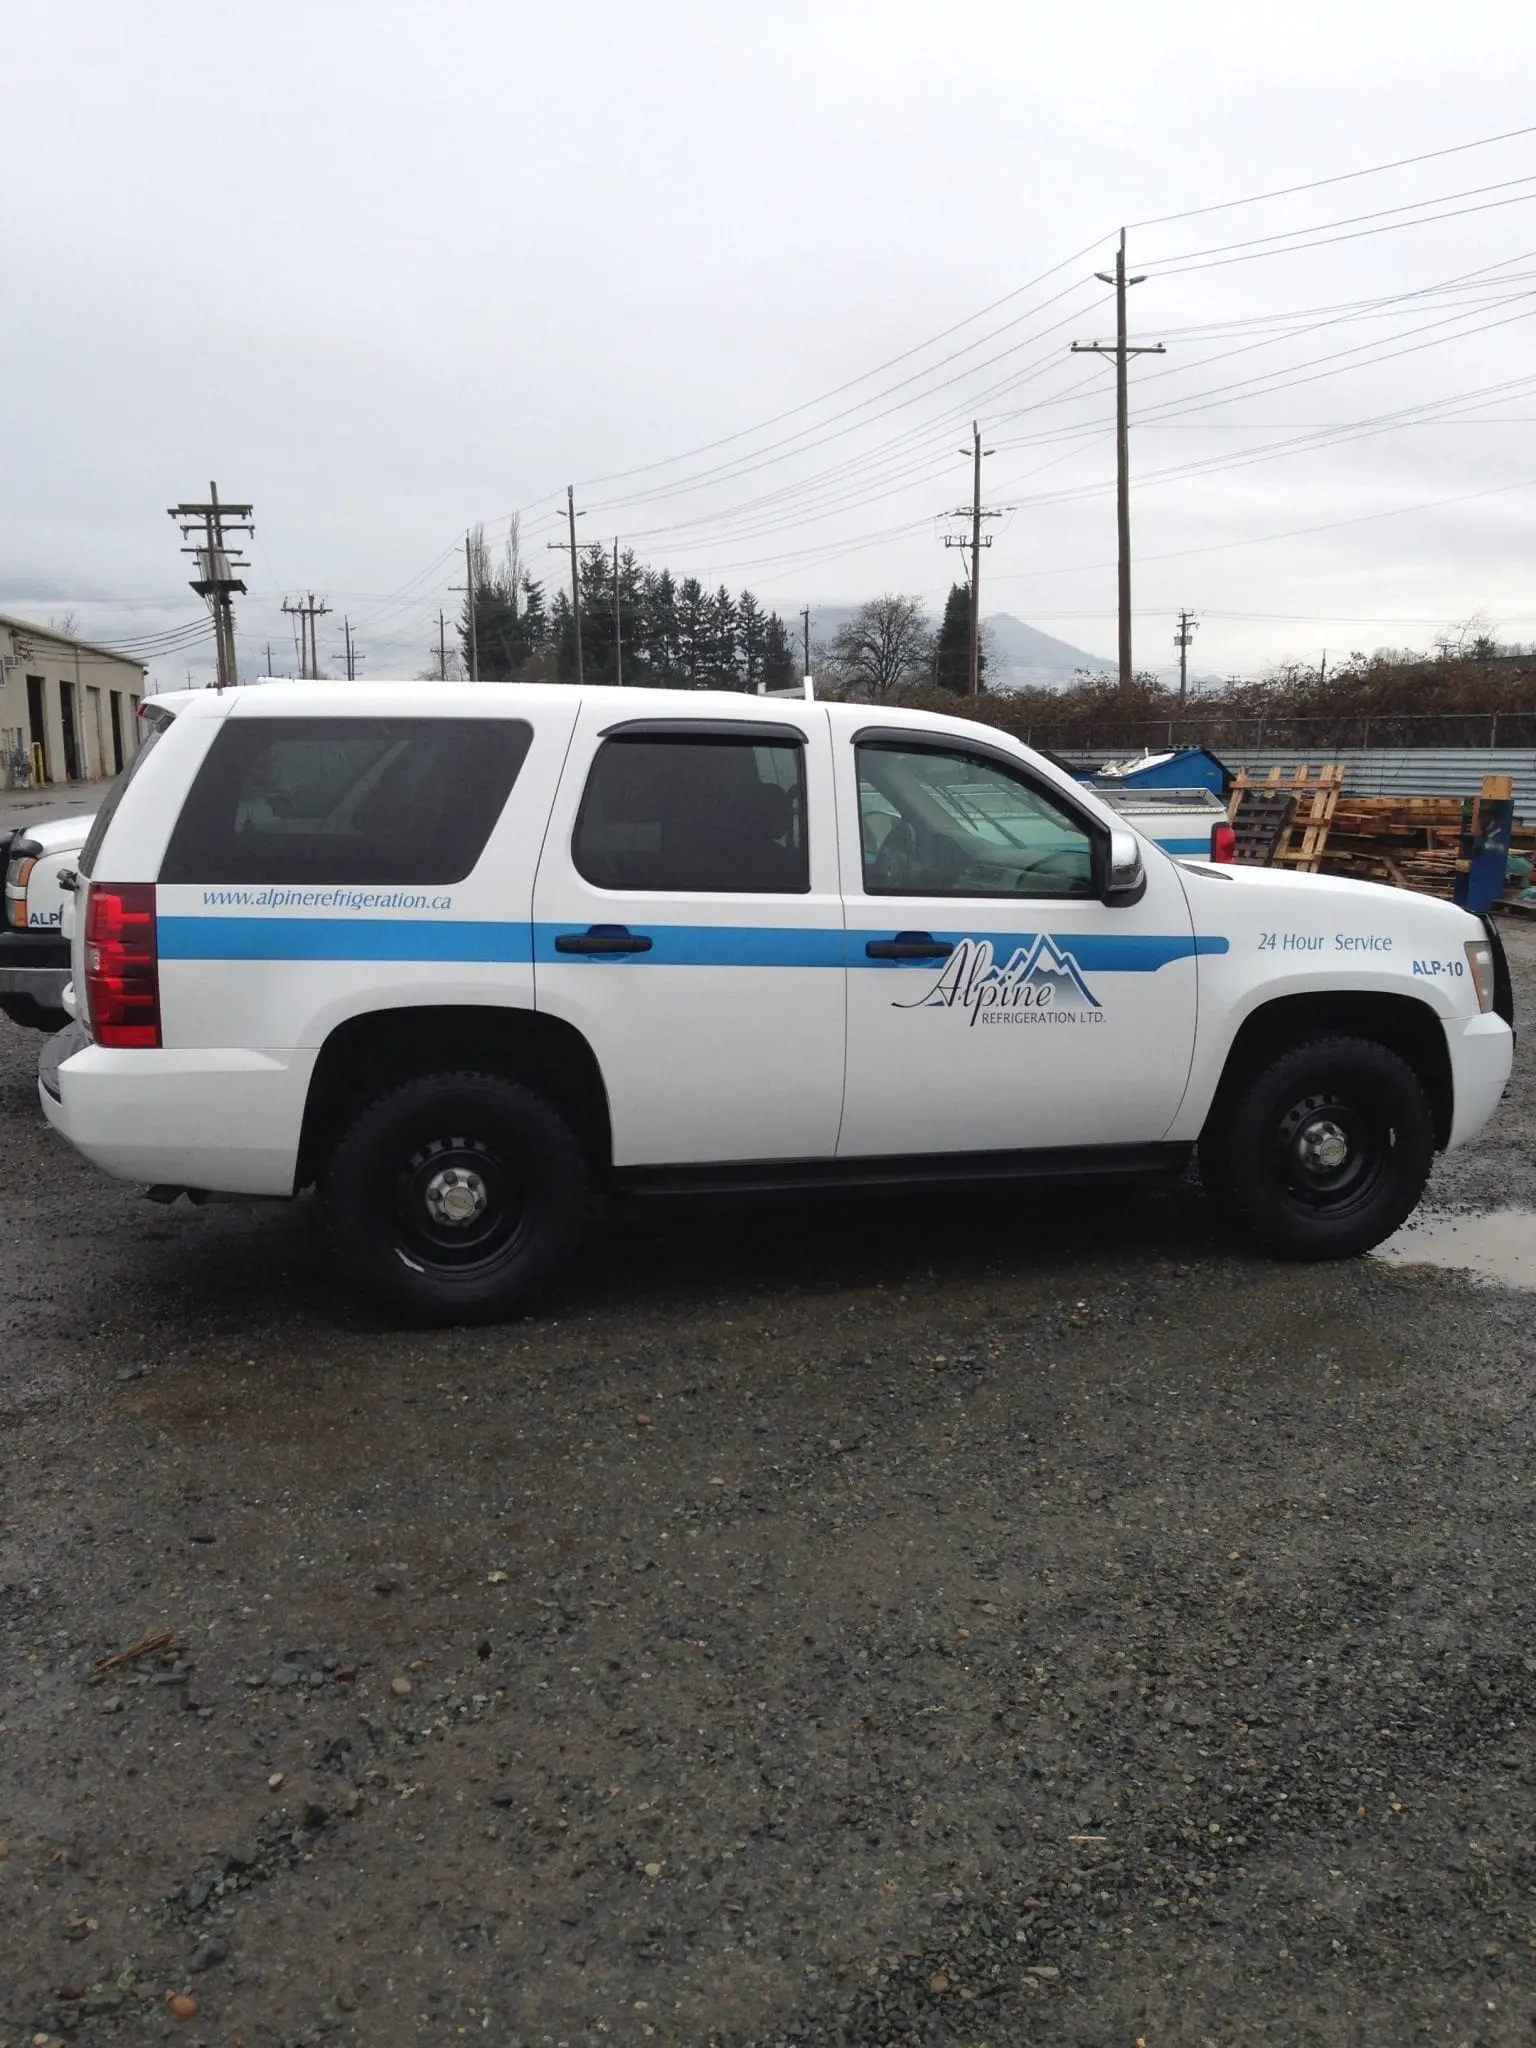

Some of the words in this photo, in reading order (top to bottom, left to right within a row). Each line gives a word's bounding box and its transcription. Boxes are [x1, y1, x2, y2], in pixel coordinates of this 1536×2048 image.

[203, 889, 452, 910] www.alpinerefrigeration.ca
[1257, 933, 1277, 950] 24
[1282, 933, 1325, 951] Hour
[1335, 934, 1393, 951] Service
[1412, 960, 1464, 977] ALP-10
[891, 942, 1052, 1027] Alpine
[982, 1011, 1076, 1025] REFRIGERATION
[1080, 1011, 1107, 1024] LTD.
